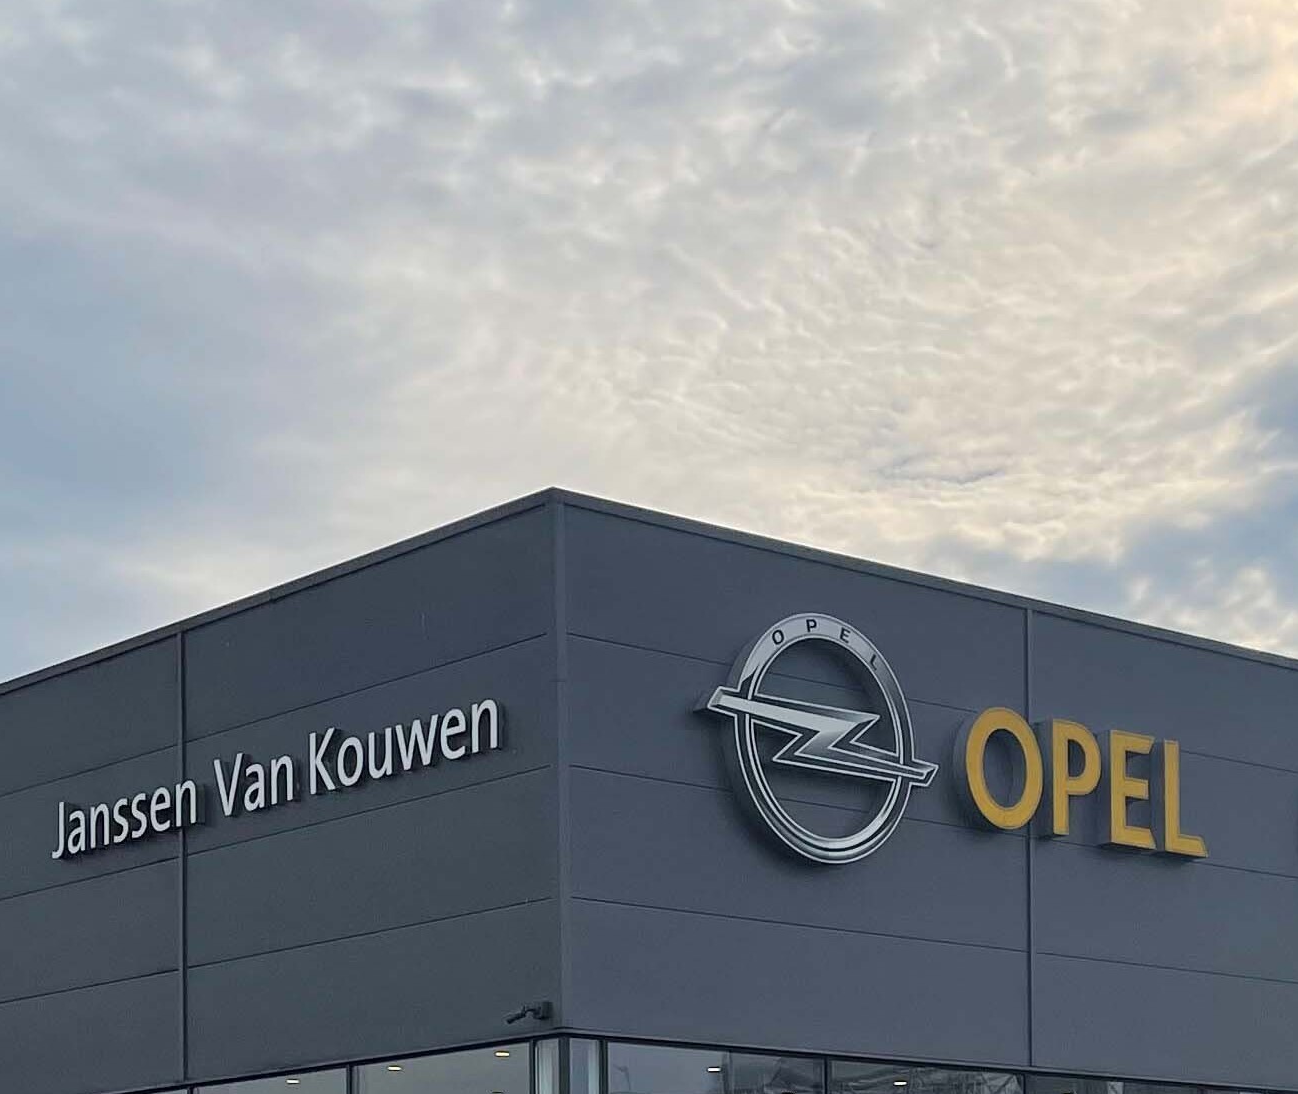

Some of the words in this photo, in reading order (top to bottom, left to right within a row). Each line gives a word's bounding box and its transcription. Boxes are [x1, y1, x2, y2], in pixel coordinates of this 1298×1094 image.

[772, 619, 878, 670] OPEL
[52, 778, 198, 860] Janssen
[213, 751, 294, 817] Van
[309, 698, 499, 796] Kouwen
[965, 706, 1208, 858] OPEL
